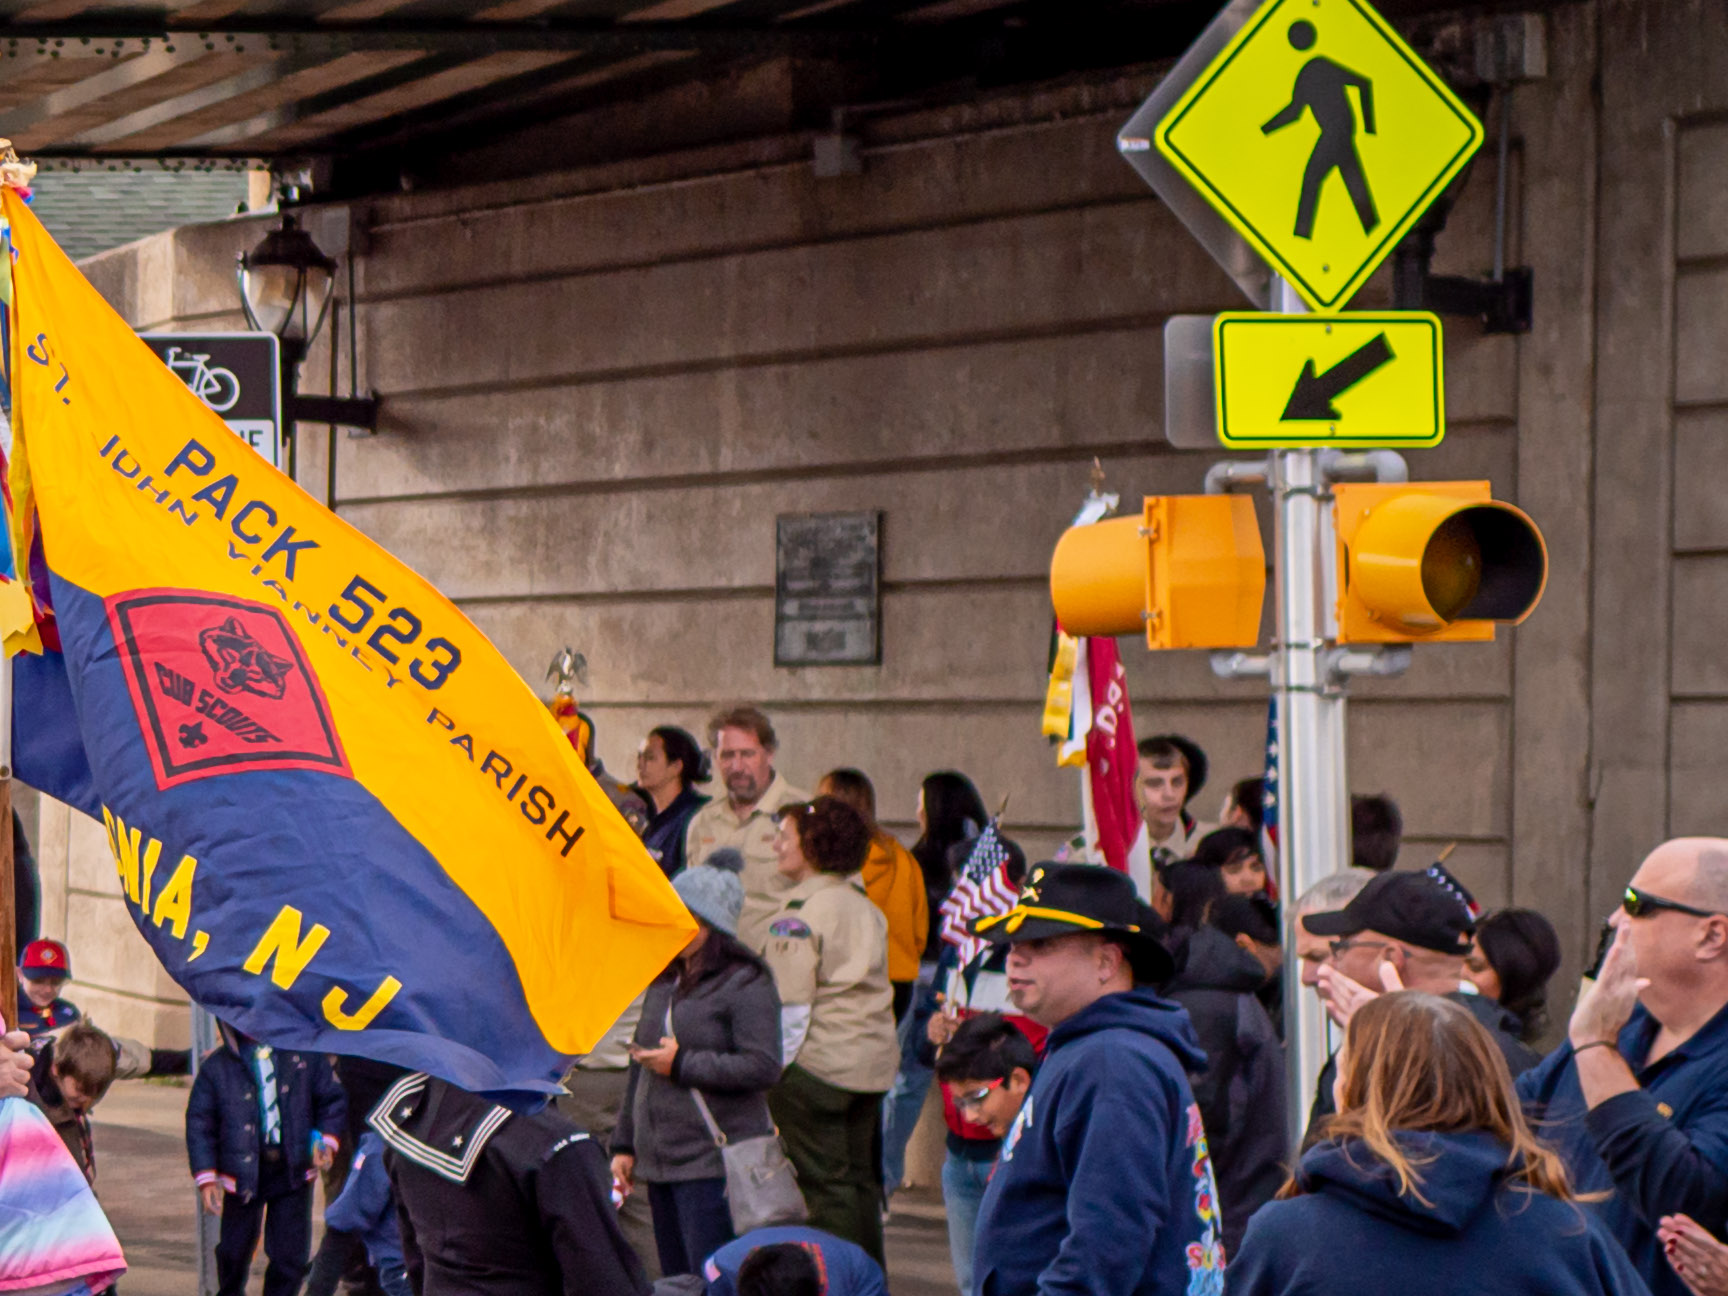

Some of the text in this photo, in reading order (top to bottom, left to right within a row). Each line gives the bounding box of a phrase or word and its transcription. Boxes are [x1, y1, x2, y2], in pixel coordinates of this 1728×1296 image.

[163, 438, 462, 692] PACK 523
[426, 707, 585, 858] PARISH
